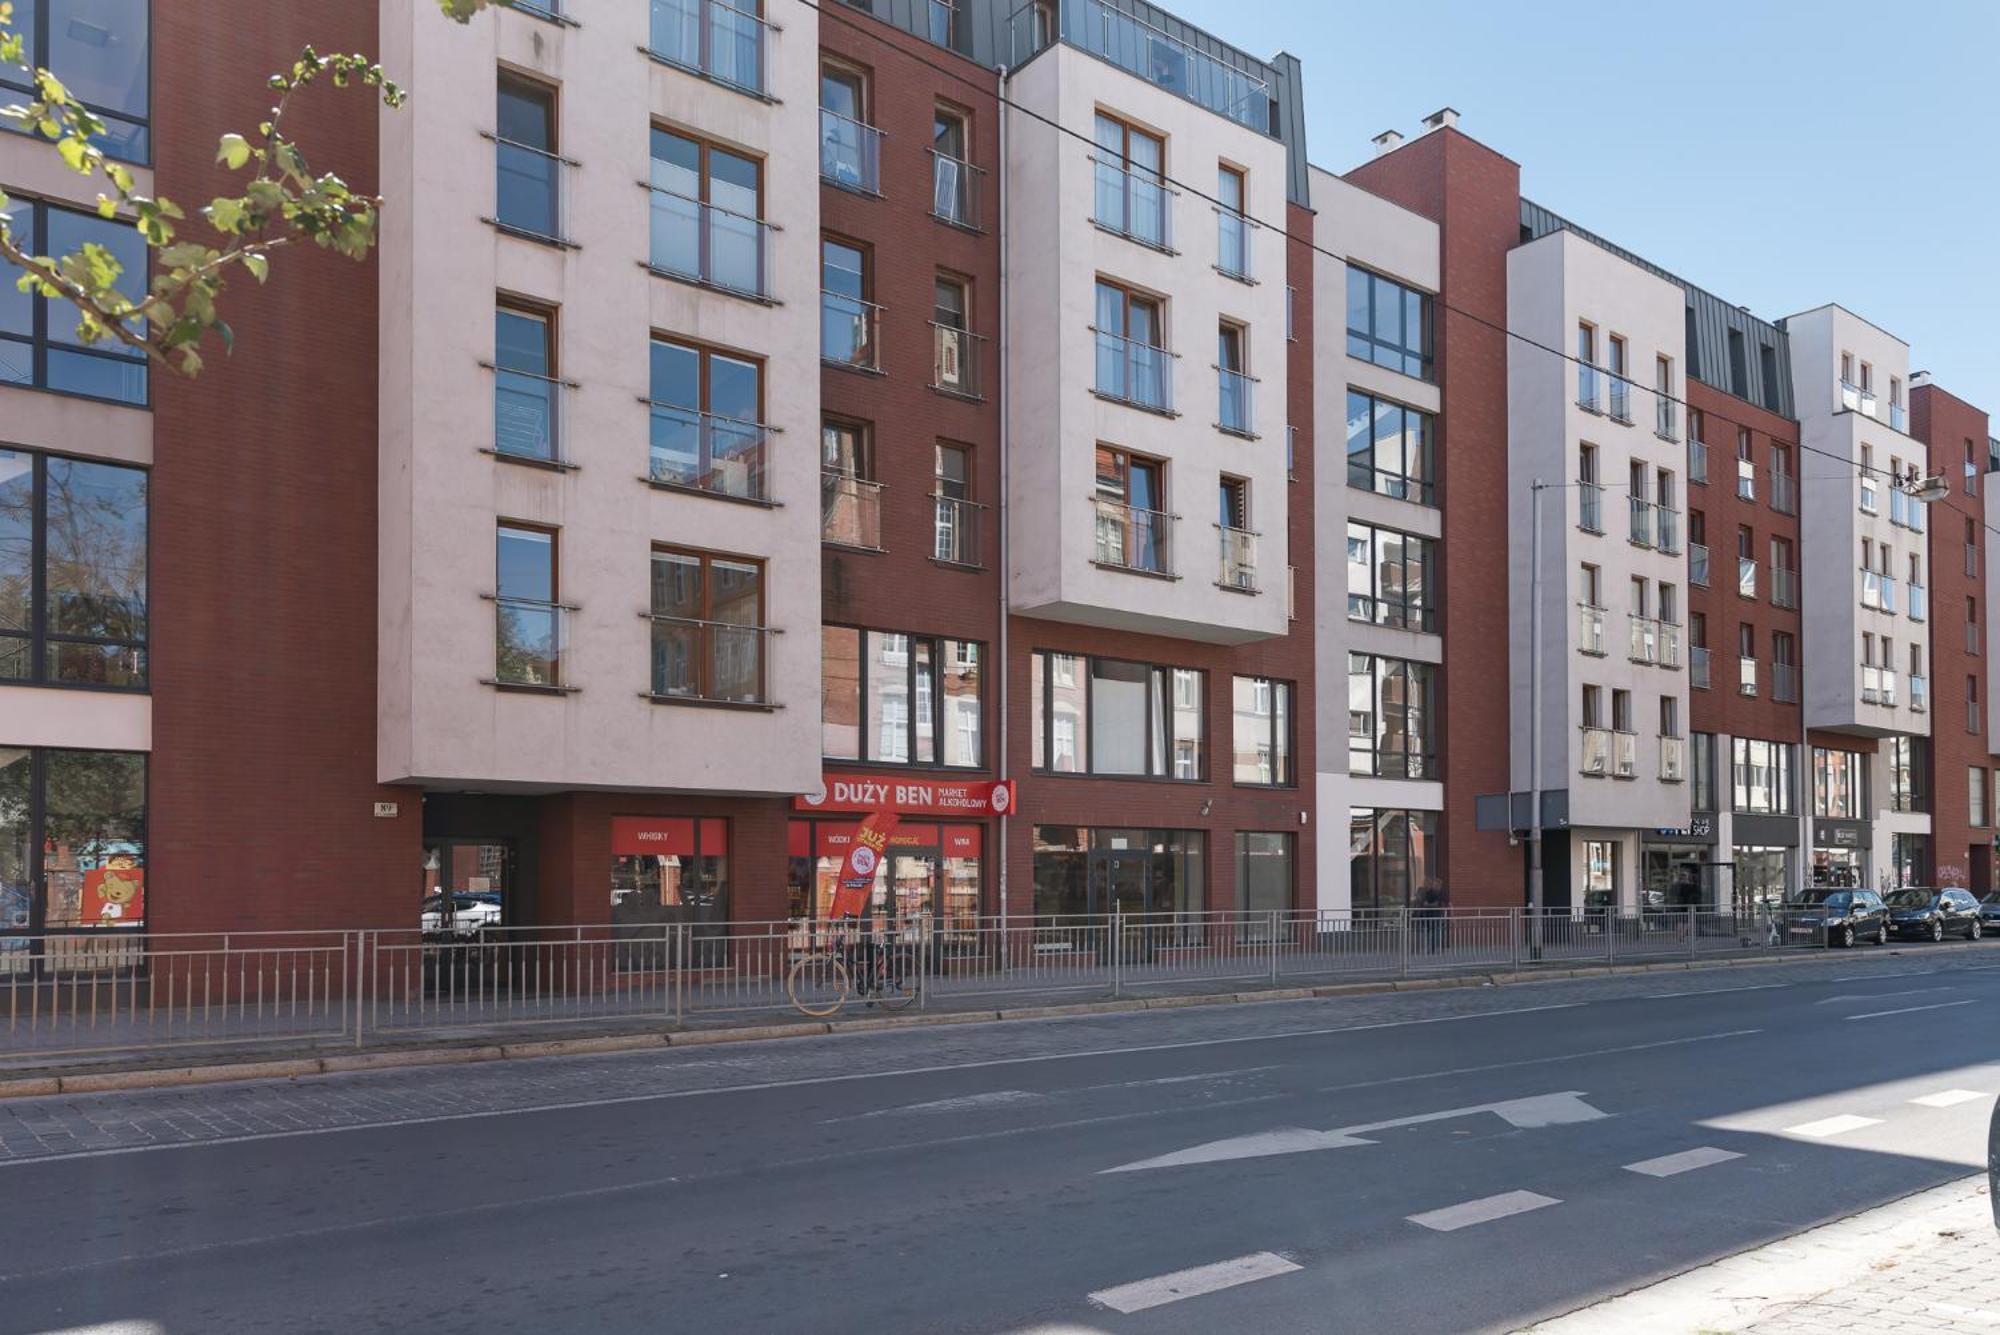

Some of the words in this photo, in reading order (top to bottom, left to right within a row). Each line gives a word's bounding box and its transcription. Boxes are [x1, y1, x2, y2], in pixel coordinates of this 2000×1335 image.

[833, 780, 889, 804] DUŻY
[895, 785, 932, 806] BEN
[938, 787, 967, 797] MARKET
[938, 797, 987, 808] ALKOHOLOWY
[637, 831, 669, 841] WHISKY
